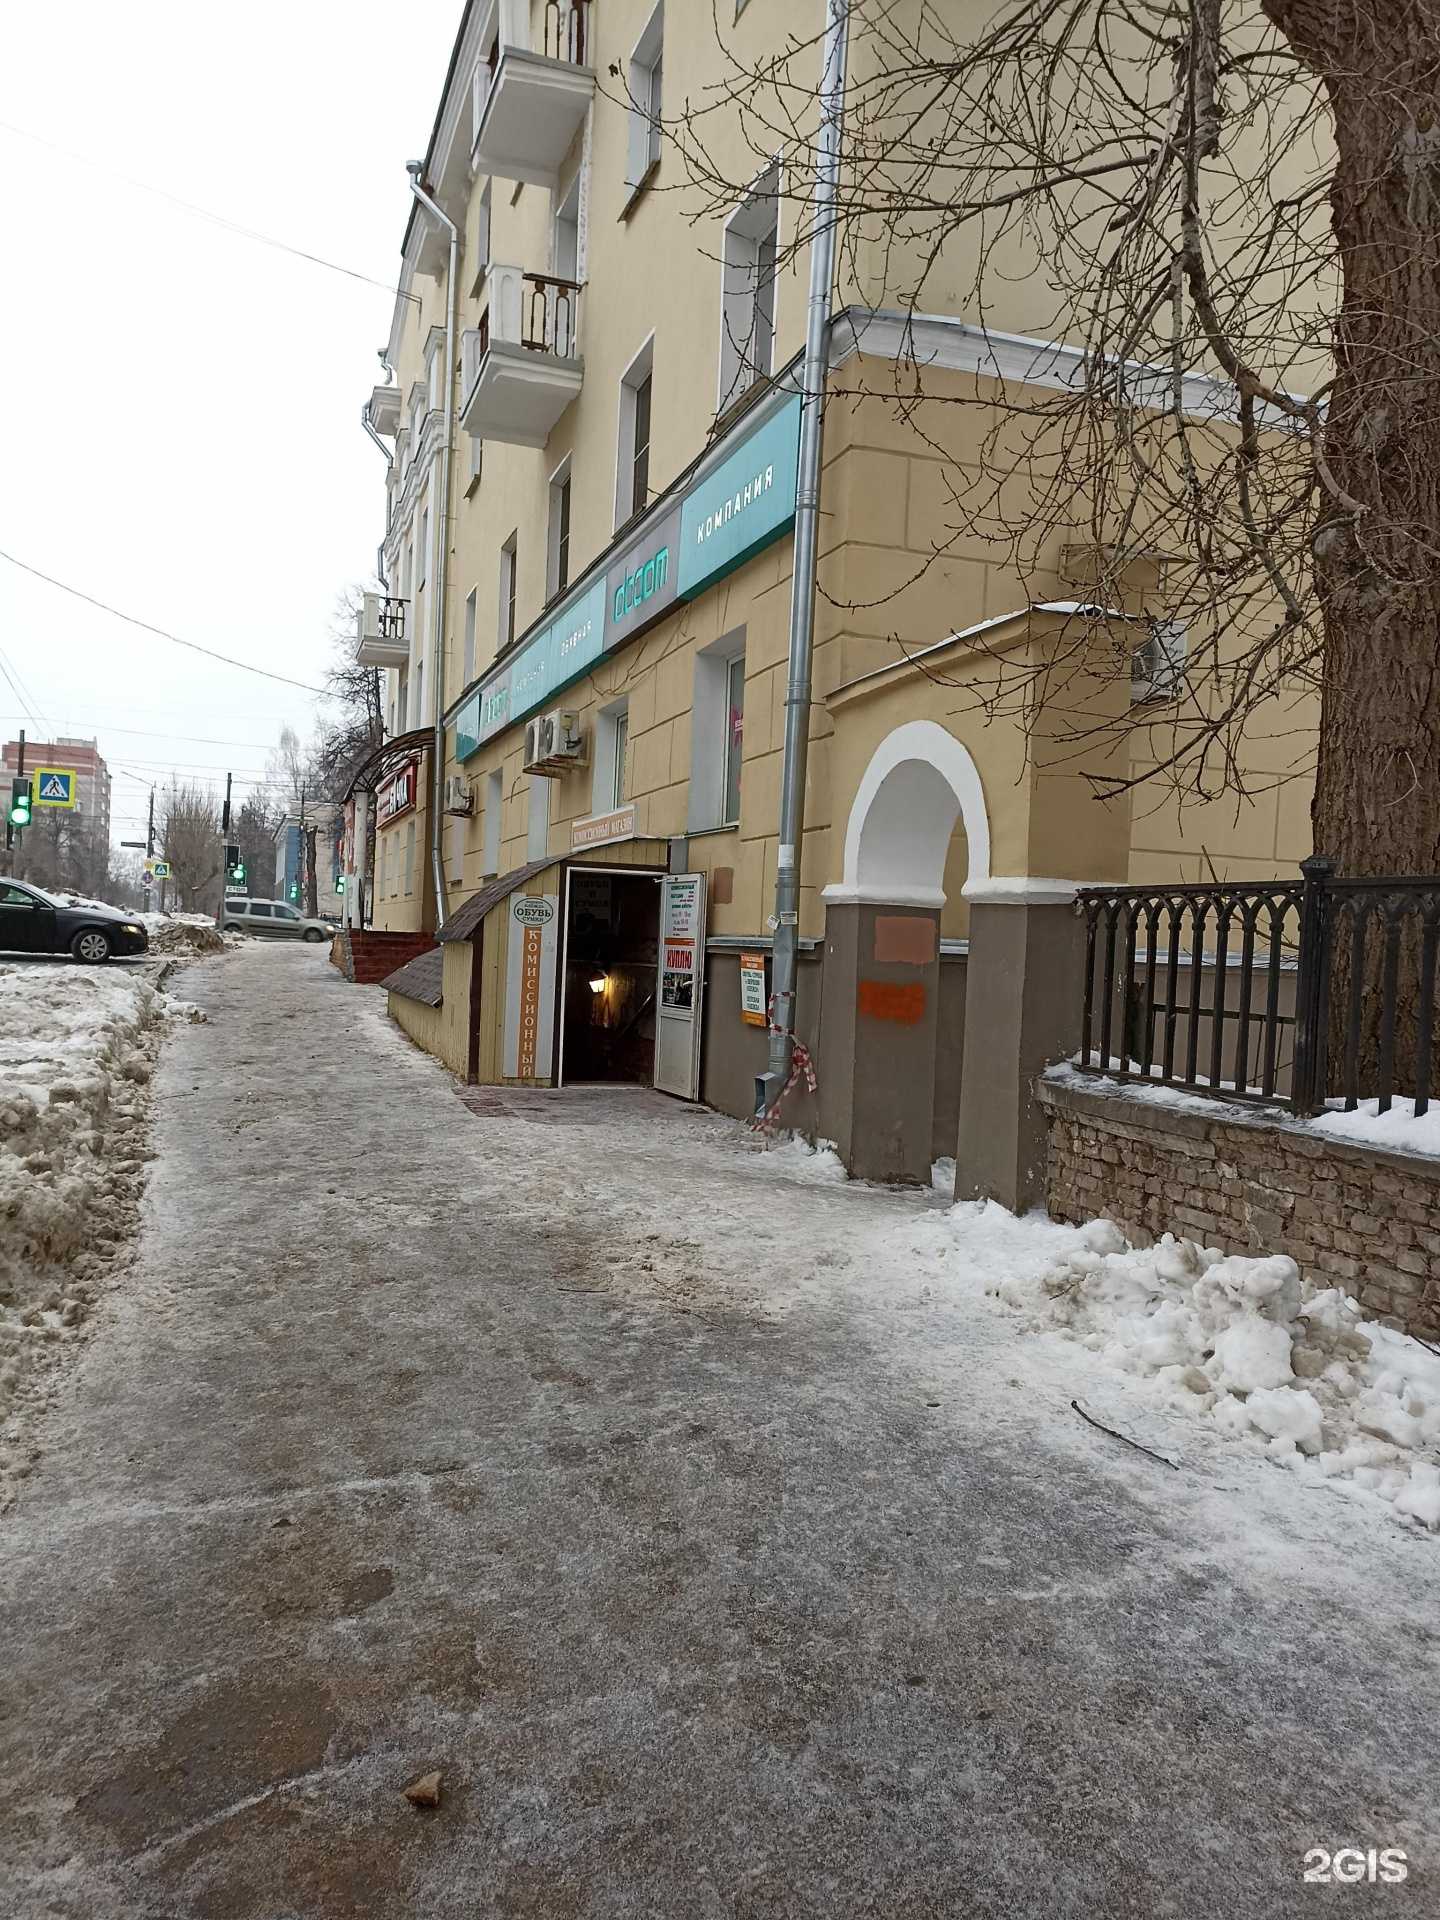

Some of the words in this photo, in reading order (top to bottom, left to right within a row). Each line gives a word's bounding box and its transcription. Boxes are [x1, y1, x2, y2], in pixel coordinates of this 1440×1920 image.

[697, 465, 773, 544] КОМПАНИЯ
[517, 908, 551, 917] ОБУВЬ
[667, 949, 692, 970] КУПЛЮ
[522, 930, 539, 1076] КОМИССИОННЫЙ
